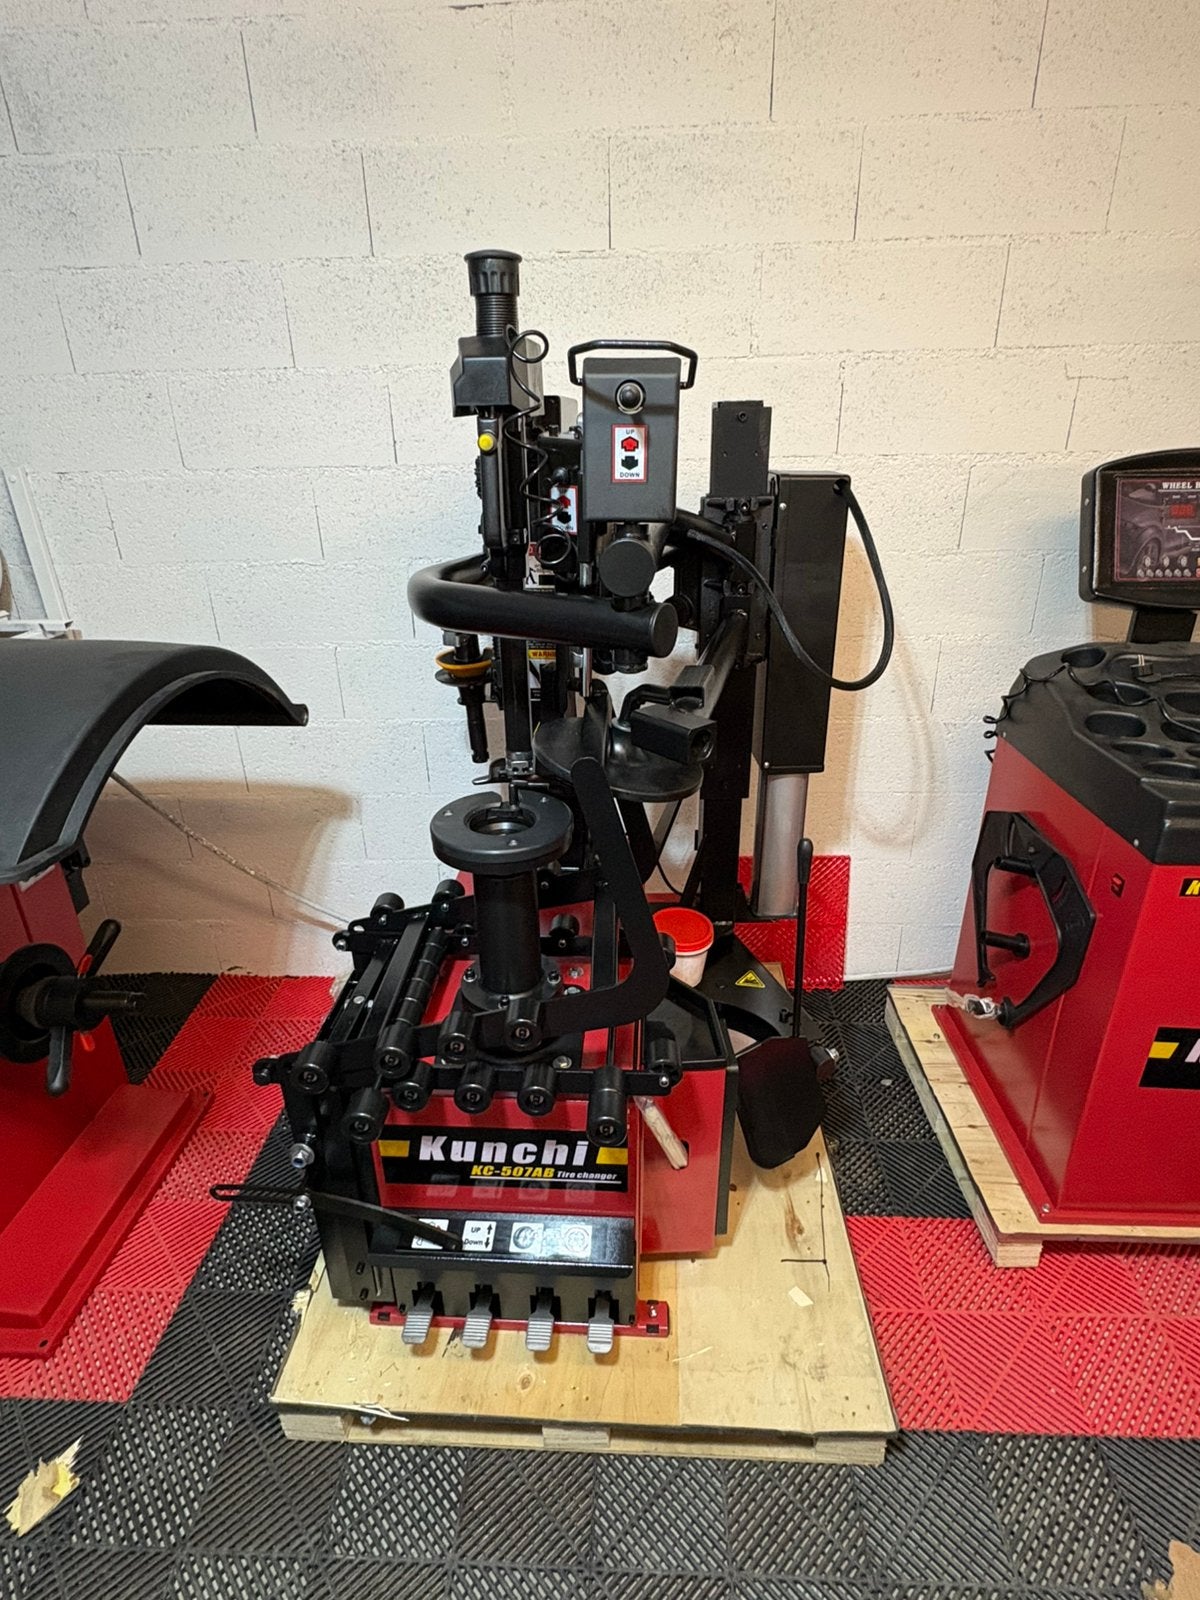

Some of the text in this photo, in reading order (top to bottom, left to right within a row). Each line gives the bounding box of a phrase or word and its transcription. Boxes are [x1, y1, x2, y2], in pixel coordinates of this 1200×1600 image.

[418, 1134, 589, 1166] Kunchi
[470, 1165, 618, 1181] KC-507AB Tire changer
